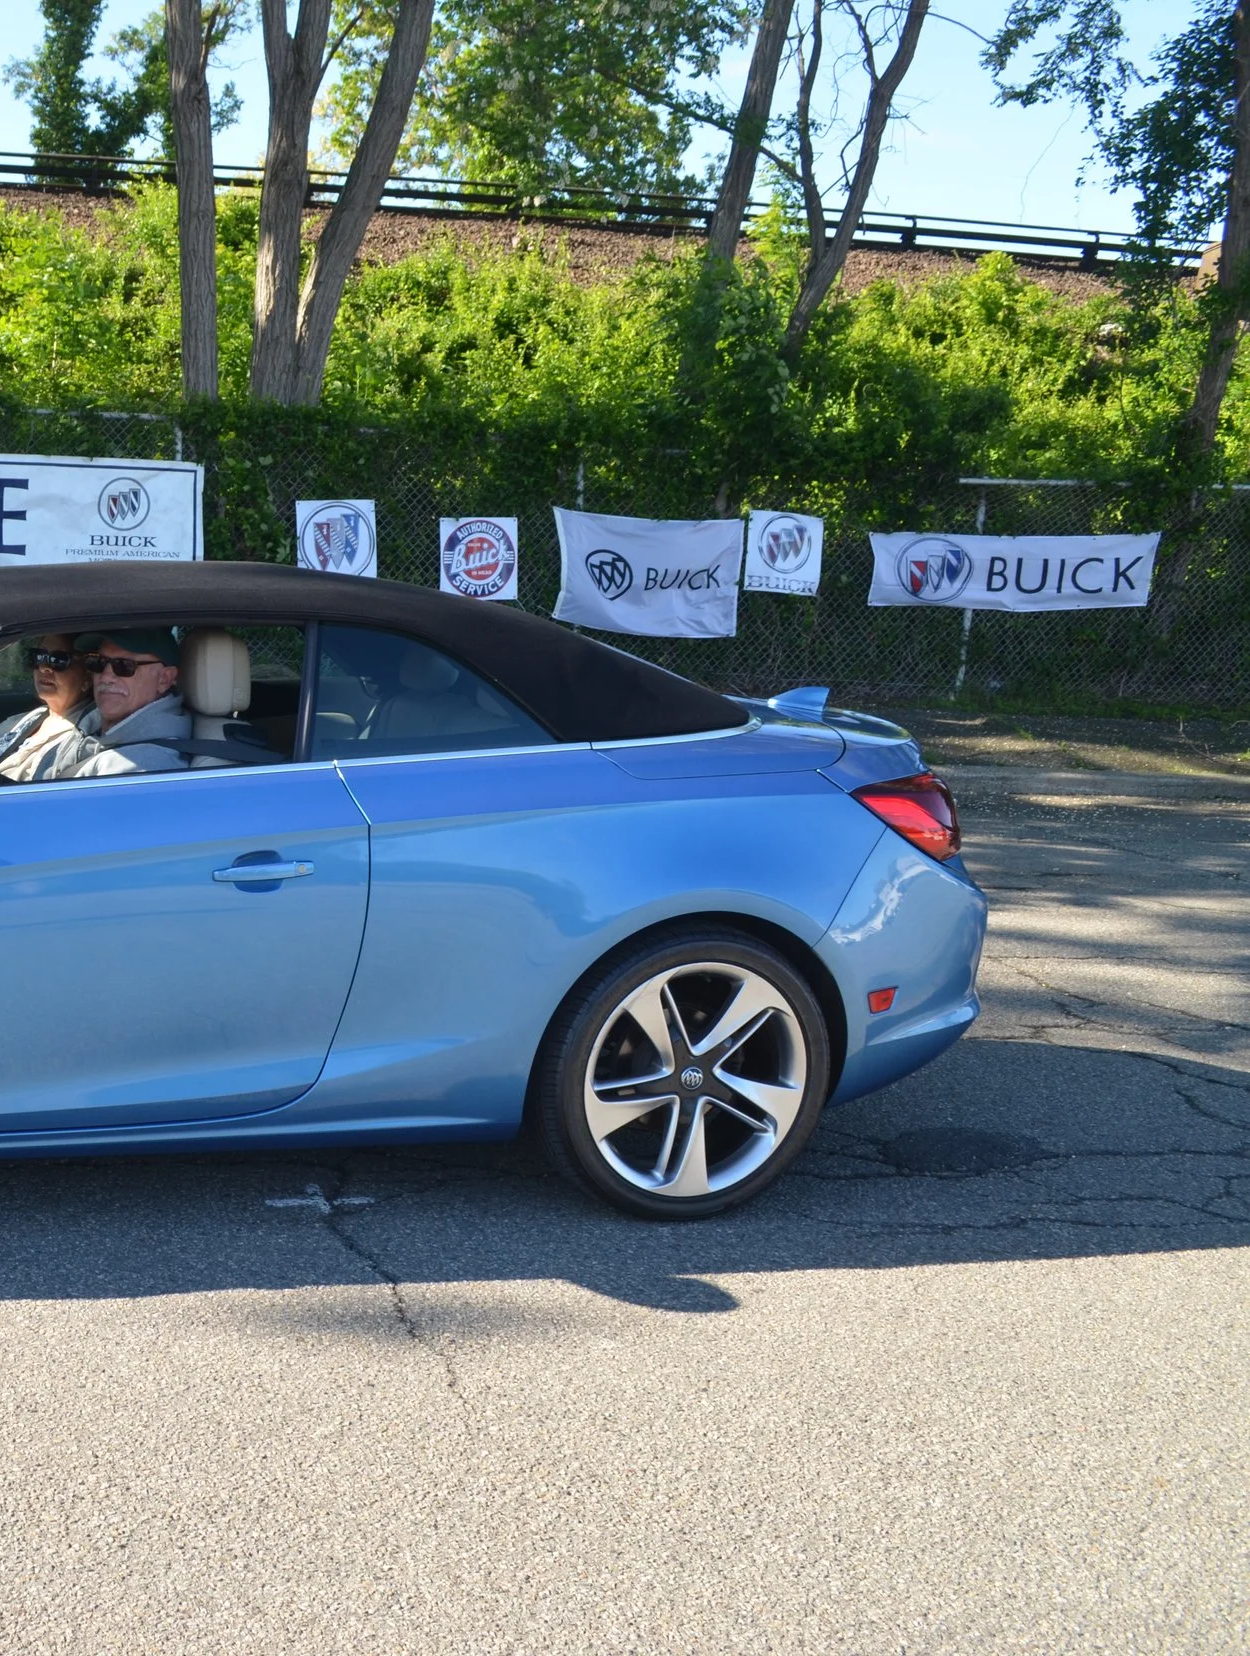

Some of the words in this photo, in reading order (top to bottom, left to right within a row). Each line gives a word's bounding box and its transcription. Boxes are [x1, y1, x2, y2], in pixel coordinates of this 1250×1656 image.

[456, 522, 504, 540] AUTHORIZED
[89, 534, 158, 548] BUICK
[65, 548, 119, 556] PREMIUM
[122, 550, 181, 559] AMERICAN
[449, 538, 511, 577] Buick
[644, 564, 721, 591] BUICK
[746, 575, 817, 593] BUICK
[986, 555, 1144, 594] BUICK
[453, 576, 504, 596] SERVICE
